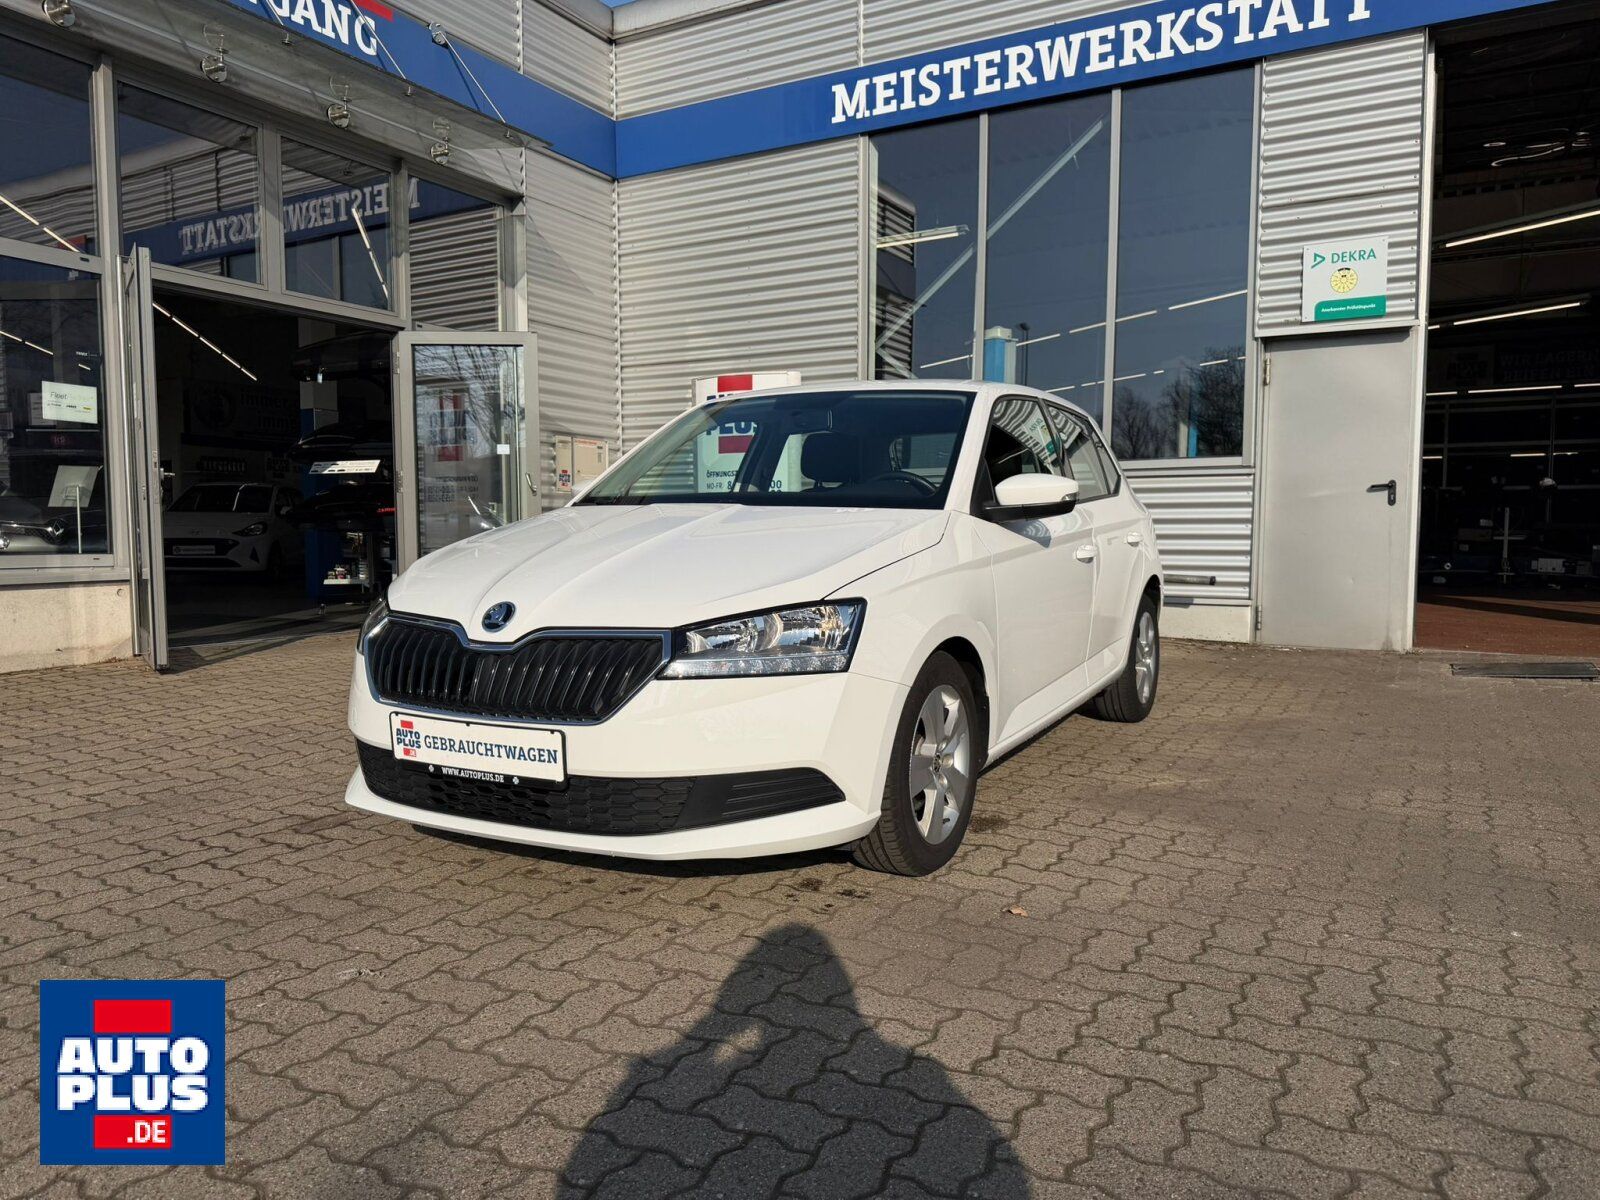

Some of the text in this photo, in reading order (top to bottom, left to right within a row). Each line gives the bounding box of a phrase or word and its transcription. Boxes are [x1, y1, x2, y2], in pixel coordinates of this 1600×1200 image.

[1331, 248, 1376, 264] DEKRA
[706, 469, 737, 479] ÖFFNUNGS
[396, 728, 421, 740] AUTO
[396, 737, 421, 749] PLUS
[424, 735, 558, 764] GEBRAUCHTWAGEN
[441, 766, 505, 783] WWW.AUTOPLUS.DE
